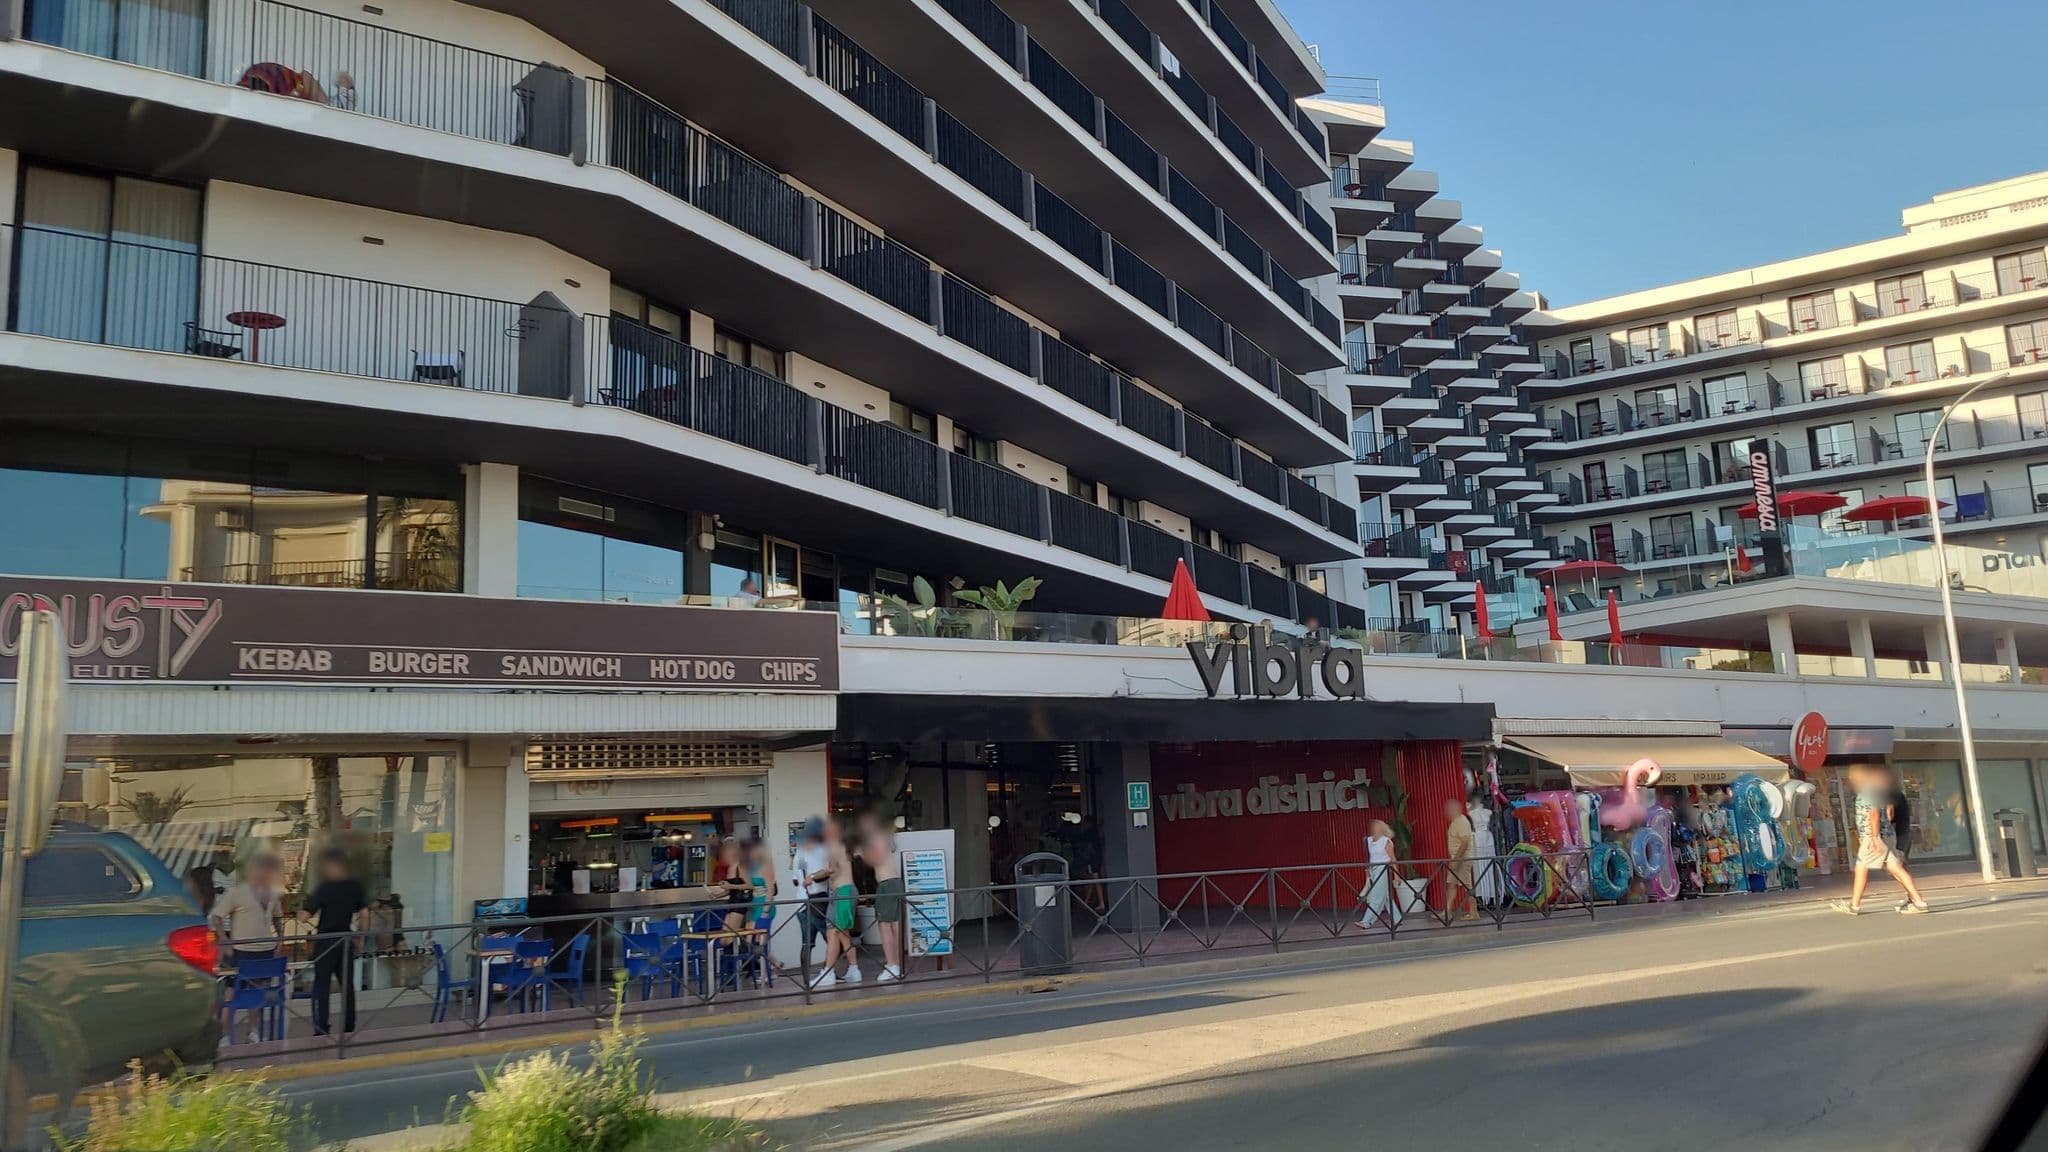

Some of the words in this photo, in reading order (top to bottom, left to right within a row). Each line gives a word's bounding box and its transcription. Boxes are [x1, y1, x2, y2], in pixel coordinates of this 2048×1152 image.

[72, 664, 151, 678] ELITE
[238, 648, 333, 672] KEBAB
[368, 651, 471, 675] BURGER
[501, 655, 622, 678] SANDWICH
[649, 660, 693, 680] HOT
[695, 661, 736, 681] DOG
[760, 662, 817, 683] CHIPS
[1186, 623, 1366, 698] vibra
[1159, 782, 1243, 821] vibra
[1246, 768, 1372, 815] district
